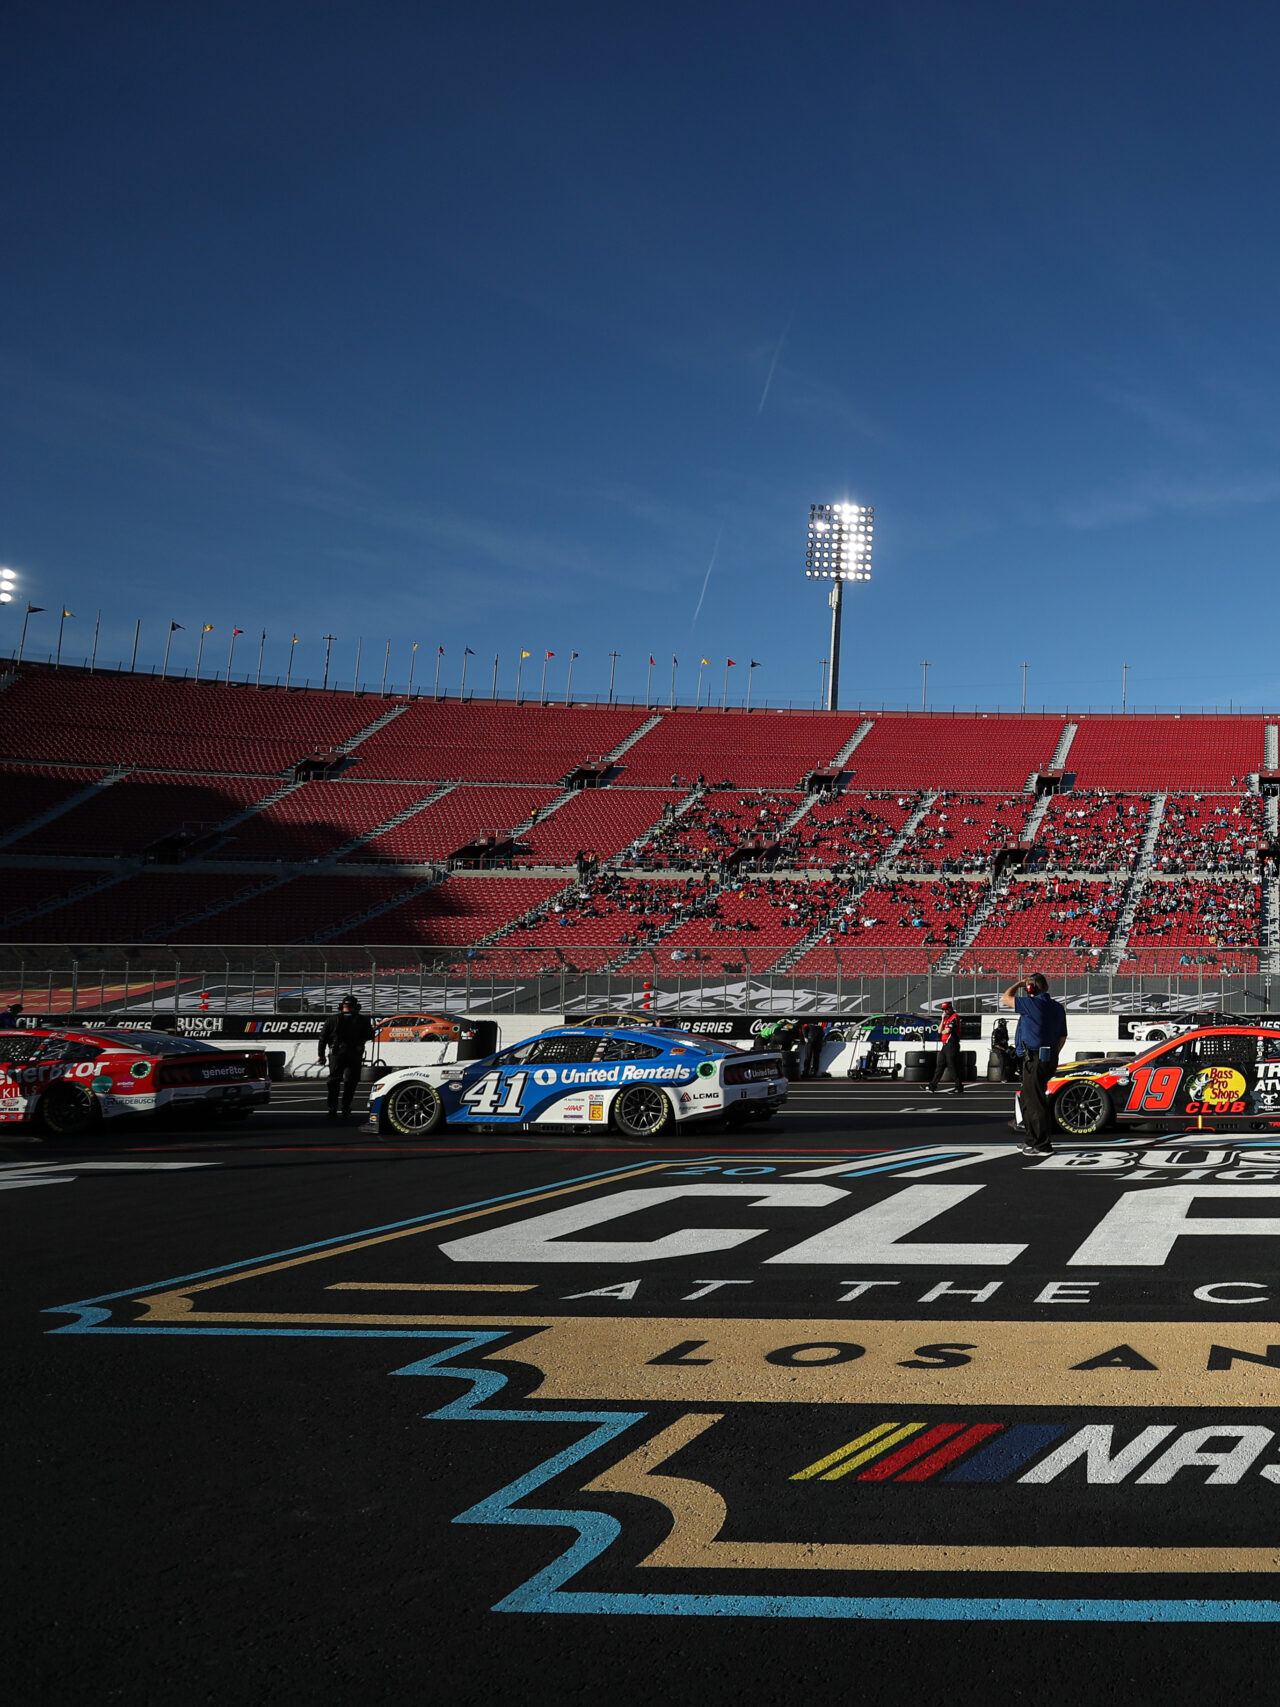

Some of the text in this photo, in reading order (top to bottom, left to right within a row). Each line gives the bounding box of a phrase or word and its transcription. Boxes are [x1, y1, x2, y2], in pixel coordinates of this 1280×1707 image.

[177, 1017, 223, 1031] BUSCH
[262, 1021, 324, 1032] CUP SERIE
[692, 1022, 733, 1033] SERIES
[883, 1025, 931, 1035] biohaven
[201, 1065, 246, 1079] gener8tor
[560, 1064, 691, 1083] United Rentals
[1210, 1067, 1233, 1079] Bass
[1124, 1066, 1184, 1112] 19
[1210, 1079, 1228, 1089] Pro
[460, 1070, 530, 1117] 41
[1210, 1088, 1240, 1101] Shops
[1185, 1101, 1247, 1114] CLUB
[661, 1165, 777, 1176] 20
[560, 1279, 753, 1301] AT
[839, 1280, 1101, 1304] THE
[645, 1339, 978, 1370] LOS
